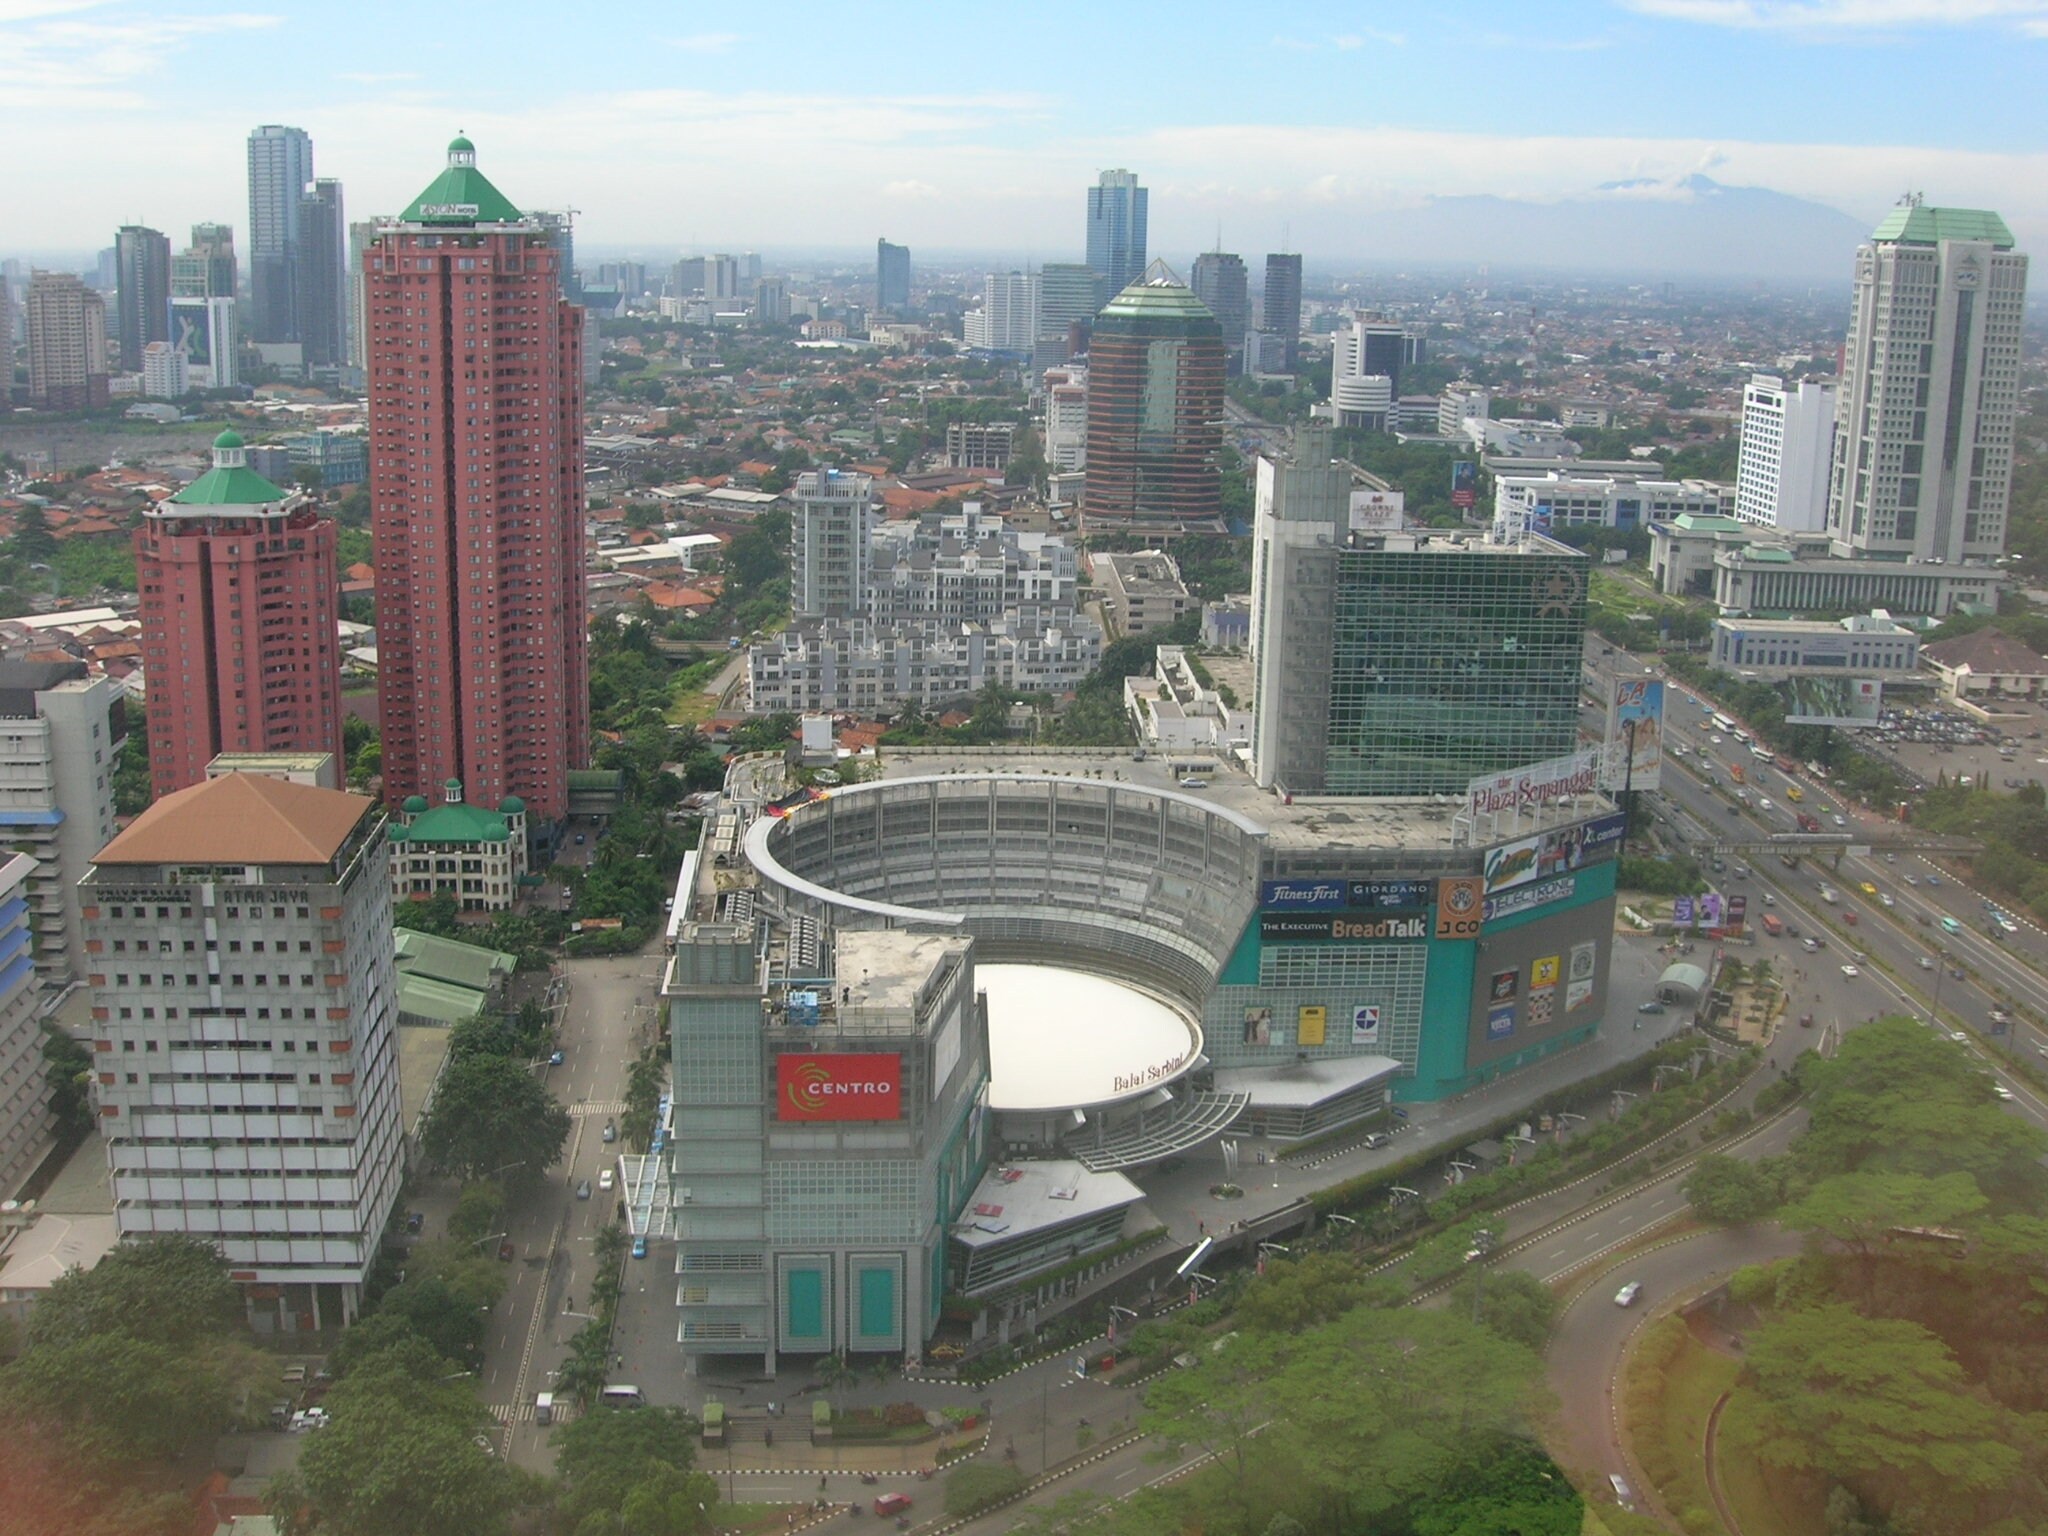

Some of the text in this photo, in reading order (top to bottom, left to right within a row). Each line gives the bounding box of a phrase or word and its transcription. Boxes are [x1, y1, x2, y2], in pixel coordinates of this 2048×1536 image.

[1473, 768, 1597, 816] Plaza Semanggi
[224, 890, 309, 904] ATMA JAYA
[1268, 885, 1340, 903] Fitness First
[1353, 885, 1428, 894] GIORDANO
[1496, 877, 1575, 908] ELECTRONIC
[1263, 922, 1329, 931] THE EXECUTIVE
[1332, 918, 1426, 938] BreadTalk
[1114, 1053, 1184, 1092] Balai Sarbini
[808, 1082, 891, 1095] CENTRO
